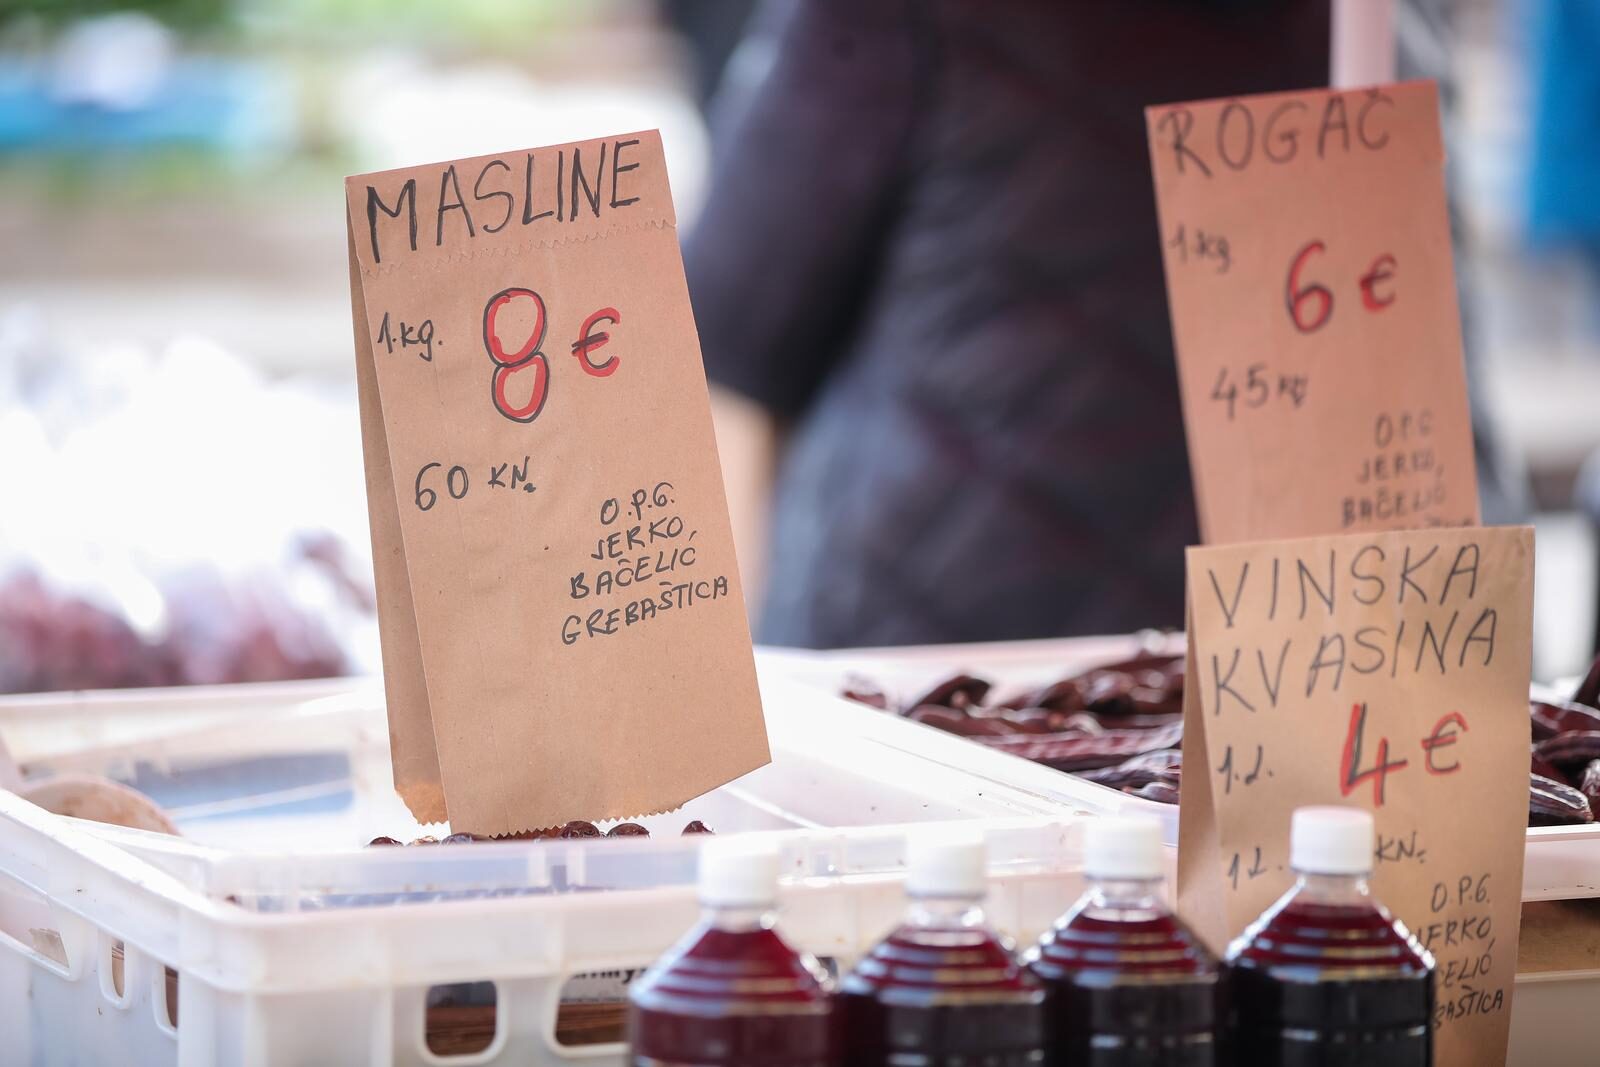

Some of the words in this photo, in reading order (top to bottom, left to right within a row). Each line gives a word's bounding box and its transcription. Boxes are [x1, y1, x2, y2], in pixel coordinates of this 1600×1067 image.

[1157, 87, 1396, 178] ROGAČ
[366, 139, 640, 264] MASLINE
[1284, 241, 1334, 334] 6
[1359, 253, 1397, 315] €
[482, 287, 550, 424] 8
[571, 307, 621, 378] €
[1208, 362, 1270, 422] 45
[414, 462, 470, 512] 60
[600, 481, 676, 525] O.P.G.
[561, 575, 729, 645] GREBAŠTICA
[1207, 543, 1481, 629] VINSKA
[1212, 607, 1498, 717] KVASINA
[1339, 702, 1409, 809] 4
[1421, 711, 1469, 776] €
[1439, 937, 1496, 989] ELIĆ
